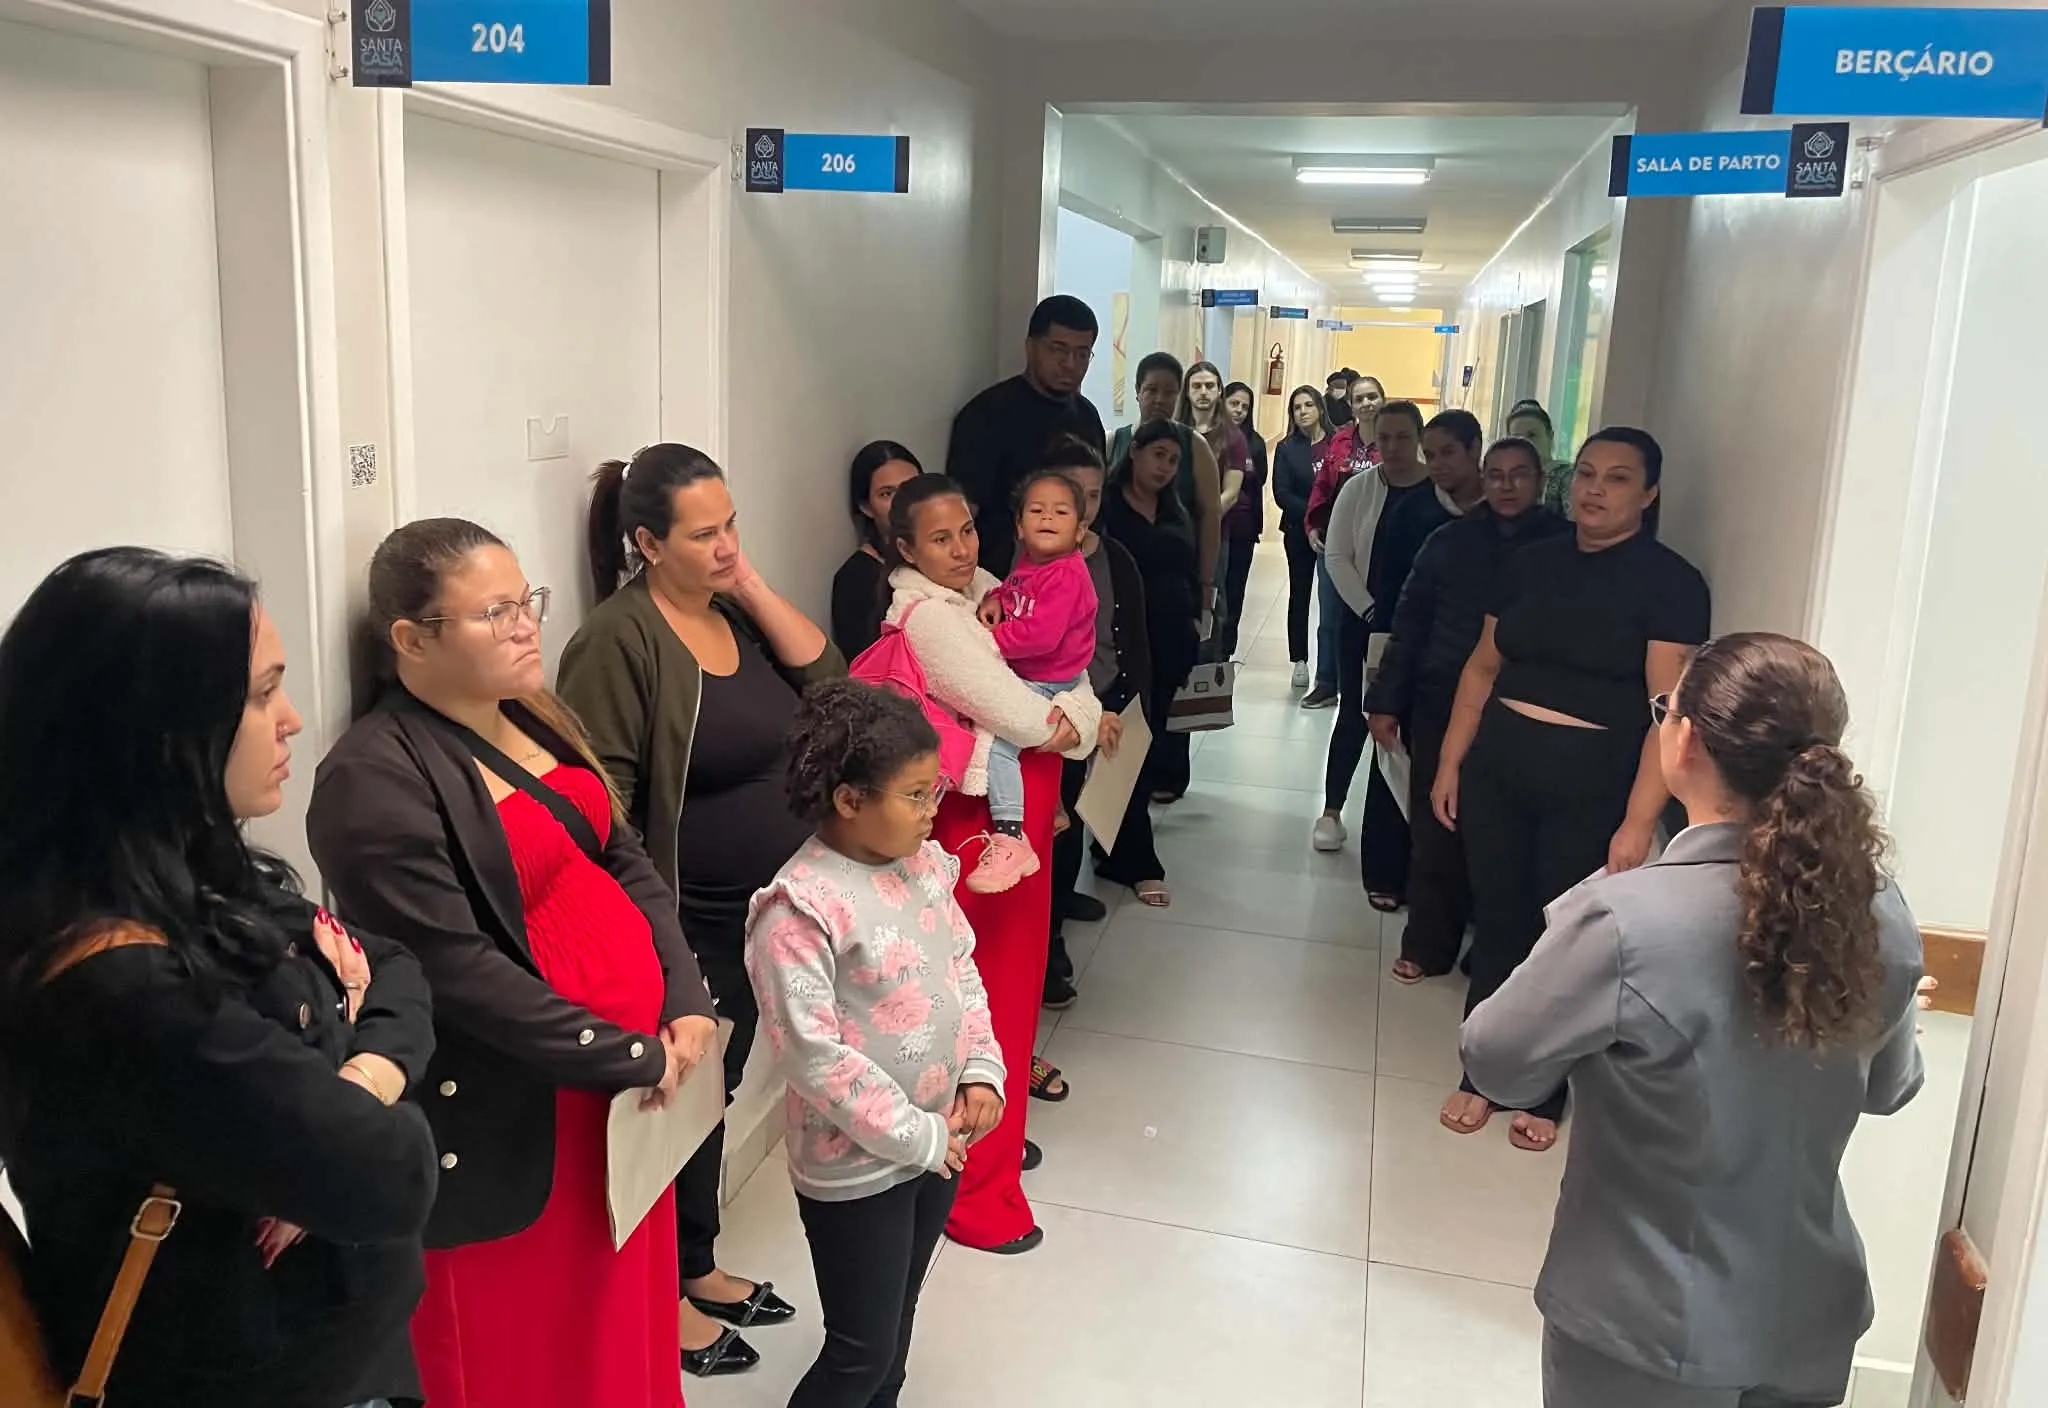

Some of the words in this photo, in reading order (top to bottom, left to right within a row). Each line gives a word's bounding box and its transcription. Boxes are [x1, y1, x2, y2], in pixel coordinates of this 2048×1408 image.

[360, 38, 403, 51] SANTA
[471, 22, 525, 53] 204
[360, 51, 403, 66] CASA
[1835, 42, 1994, 82] BERÇÁRIO
[751, 160, 778, 170] SANTA
[821, 153, 856, 173] 206
[1636, 157, 1682, 172] SALA
[1688, 156, 1713, 171] DE
[1719, 154, 1780, 170] PARTO
[1795, 161, 1838, 173] SANTA
